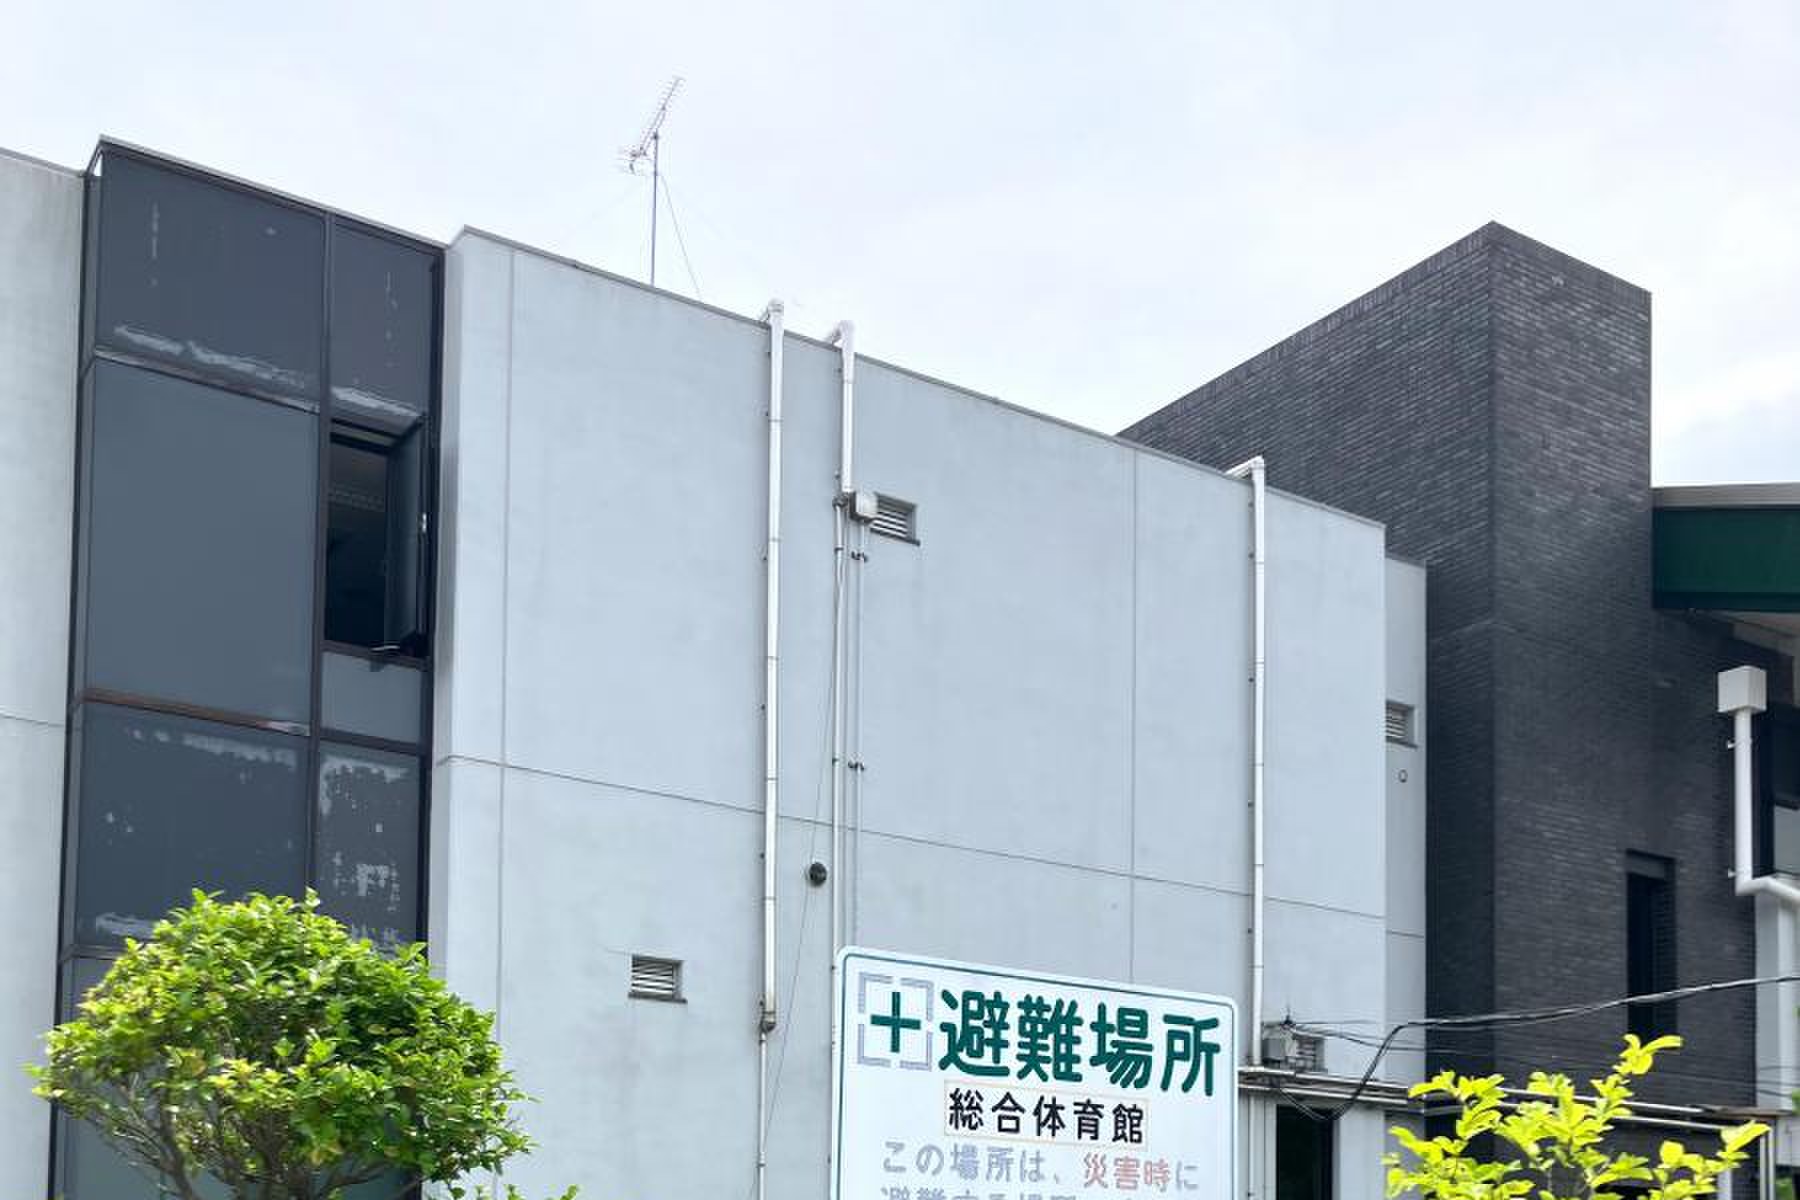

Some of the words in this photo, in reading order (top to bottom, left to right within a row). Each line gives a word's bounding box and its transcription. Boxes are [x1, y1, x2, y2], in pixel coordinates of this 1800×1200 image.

[938, 989, 1221, 1097] 避難場所
[949, 1087, 1144, 1144] 総合体育館
[883, 1141, 1199, 1193] この場所は、災害時に
